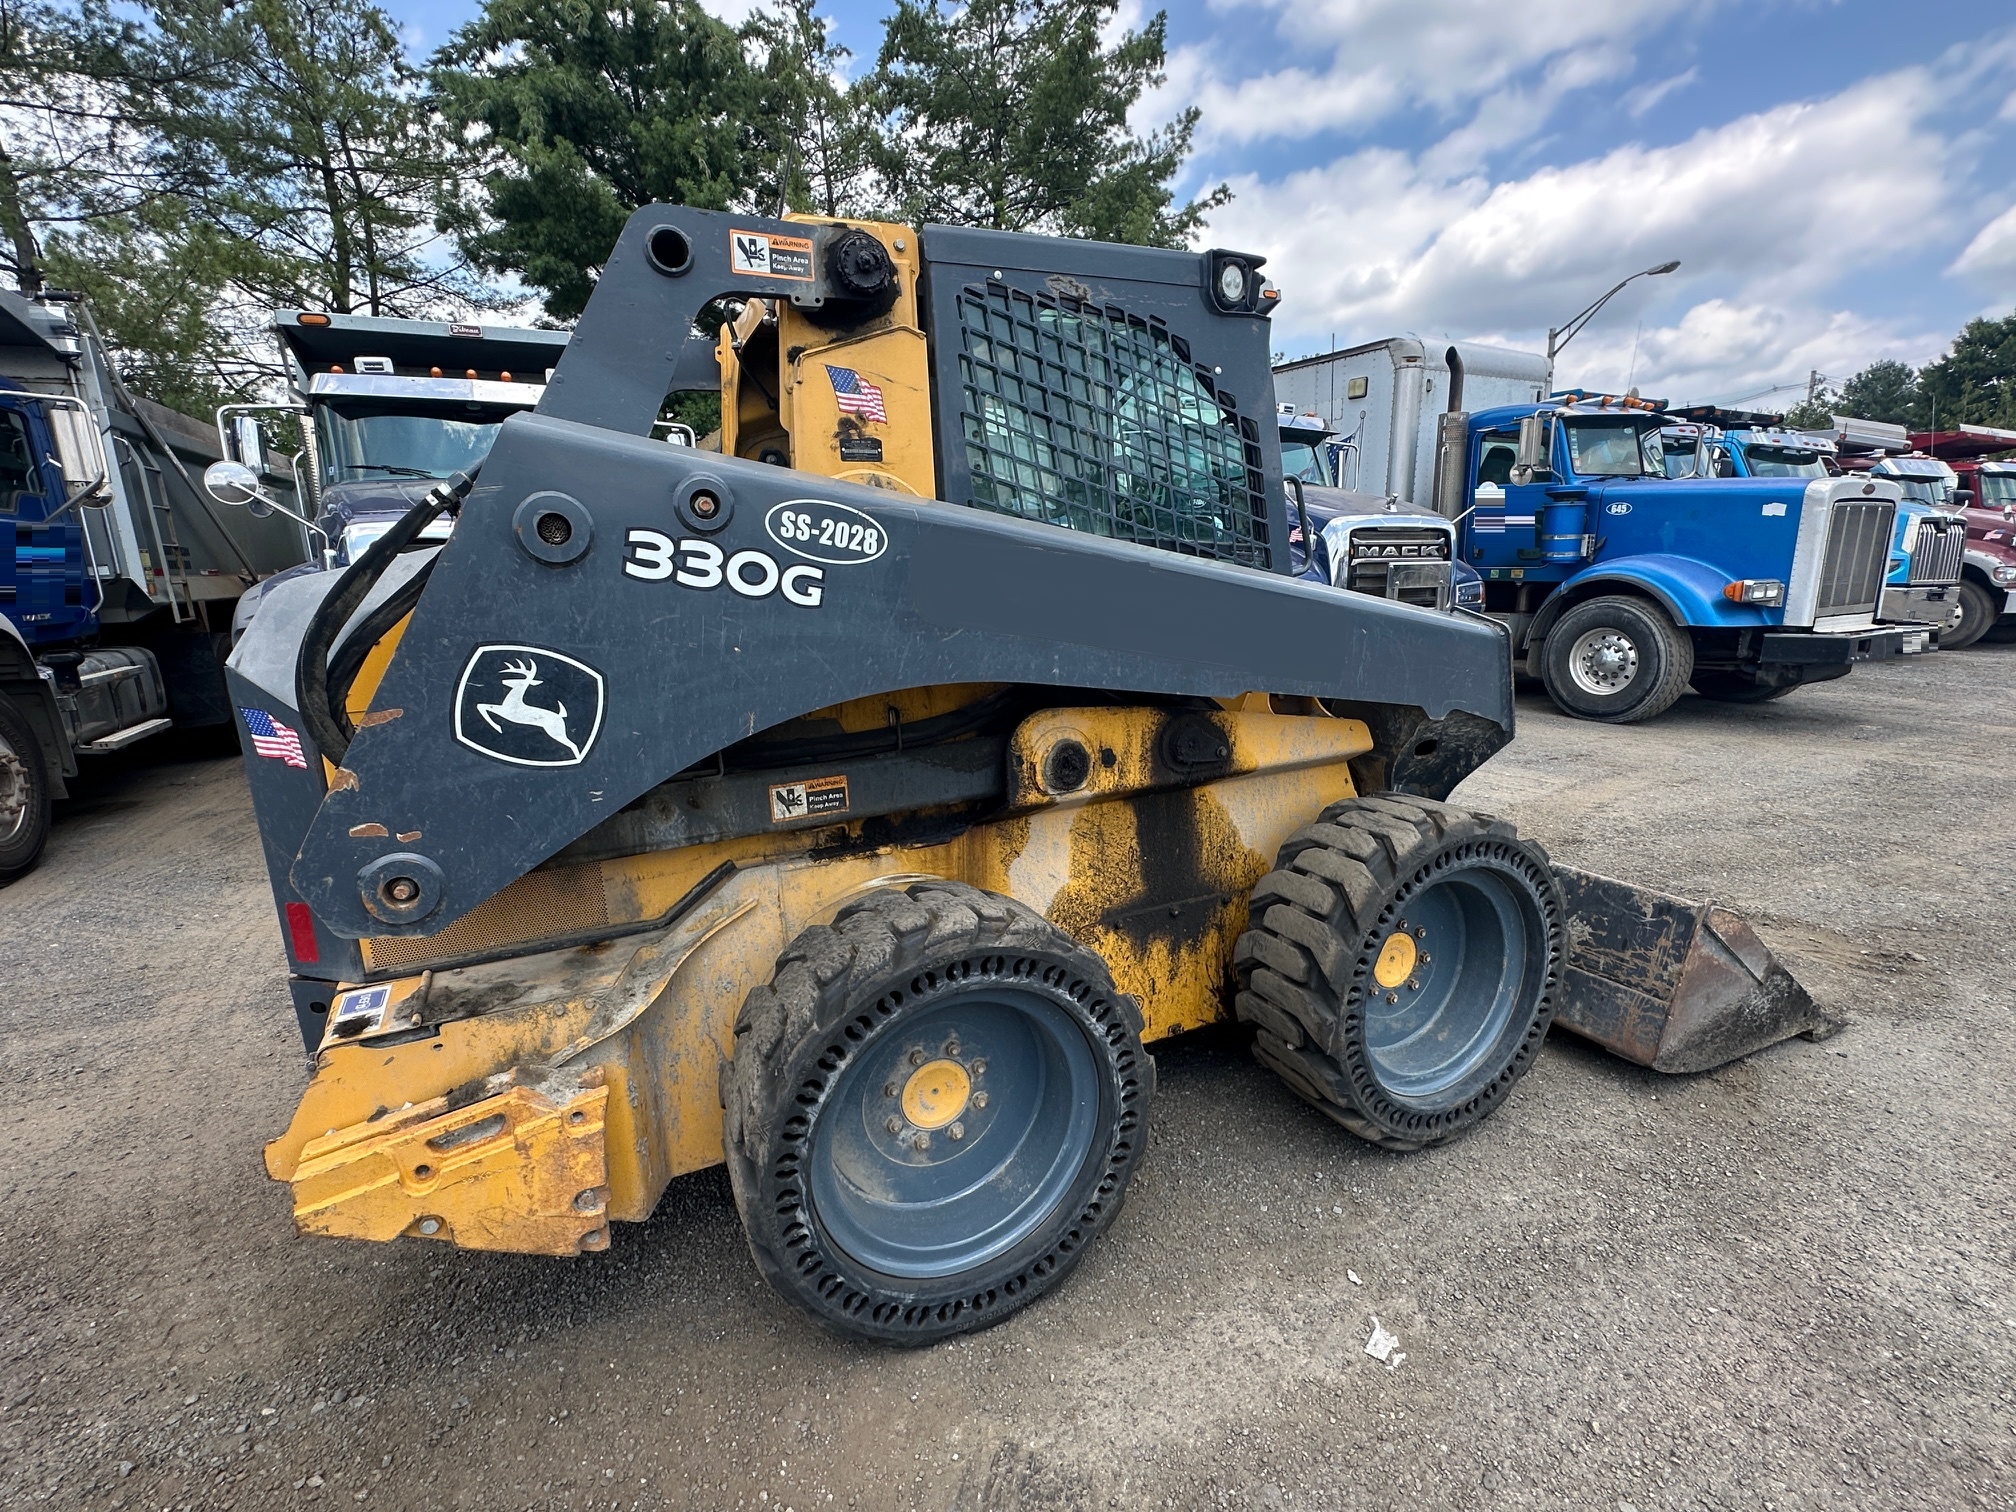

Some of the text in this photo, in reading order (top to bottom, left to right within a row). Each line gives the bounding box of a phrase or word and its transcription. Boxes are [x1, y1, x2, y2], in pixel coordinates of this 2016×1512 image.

[778, 239, 810, 250] WARNING
[772, 253, 809, 265] Pinch Area
[772, 262, 804, 273] Keep Away
[1611, 504, 1627, 514] 645
[780, 510, 879, 555] SS-2028
[1358, 545, 1440, 557] MACK
[624, 529, 824, 608] 330G
[815, 779, 844, 789] WARNING
[809, 794, 828, 802] Pinch
[824, 800, 840, 808] Away
